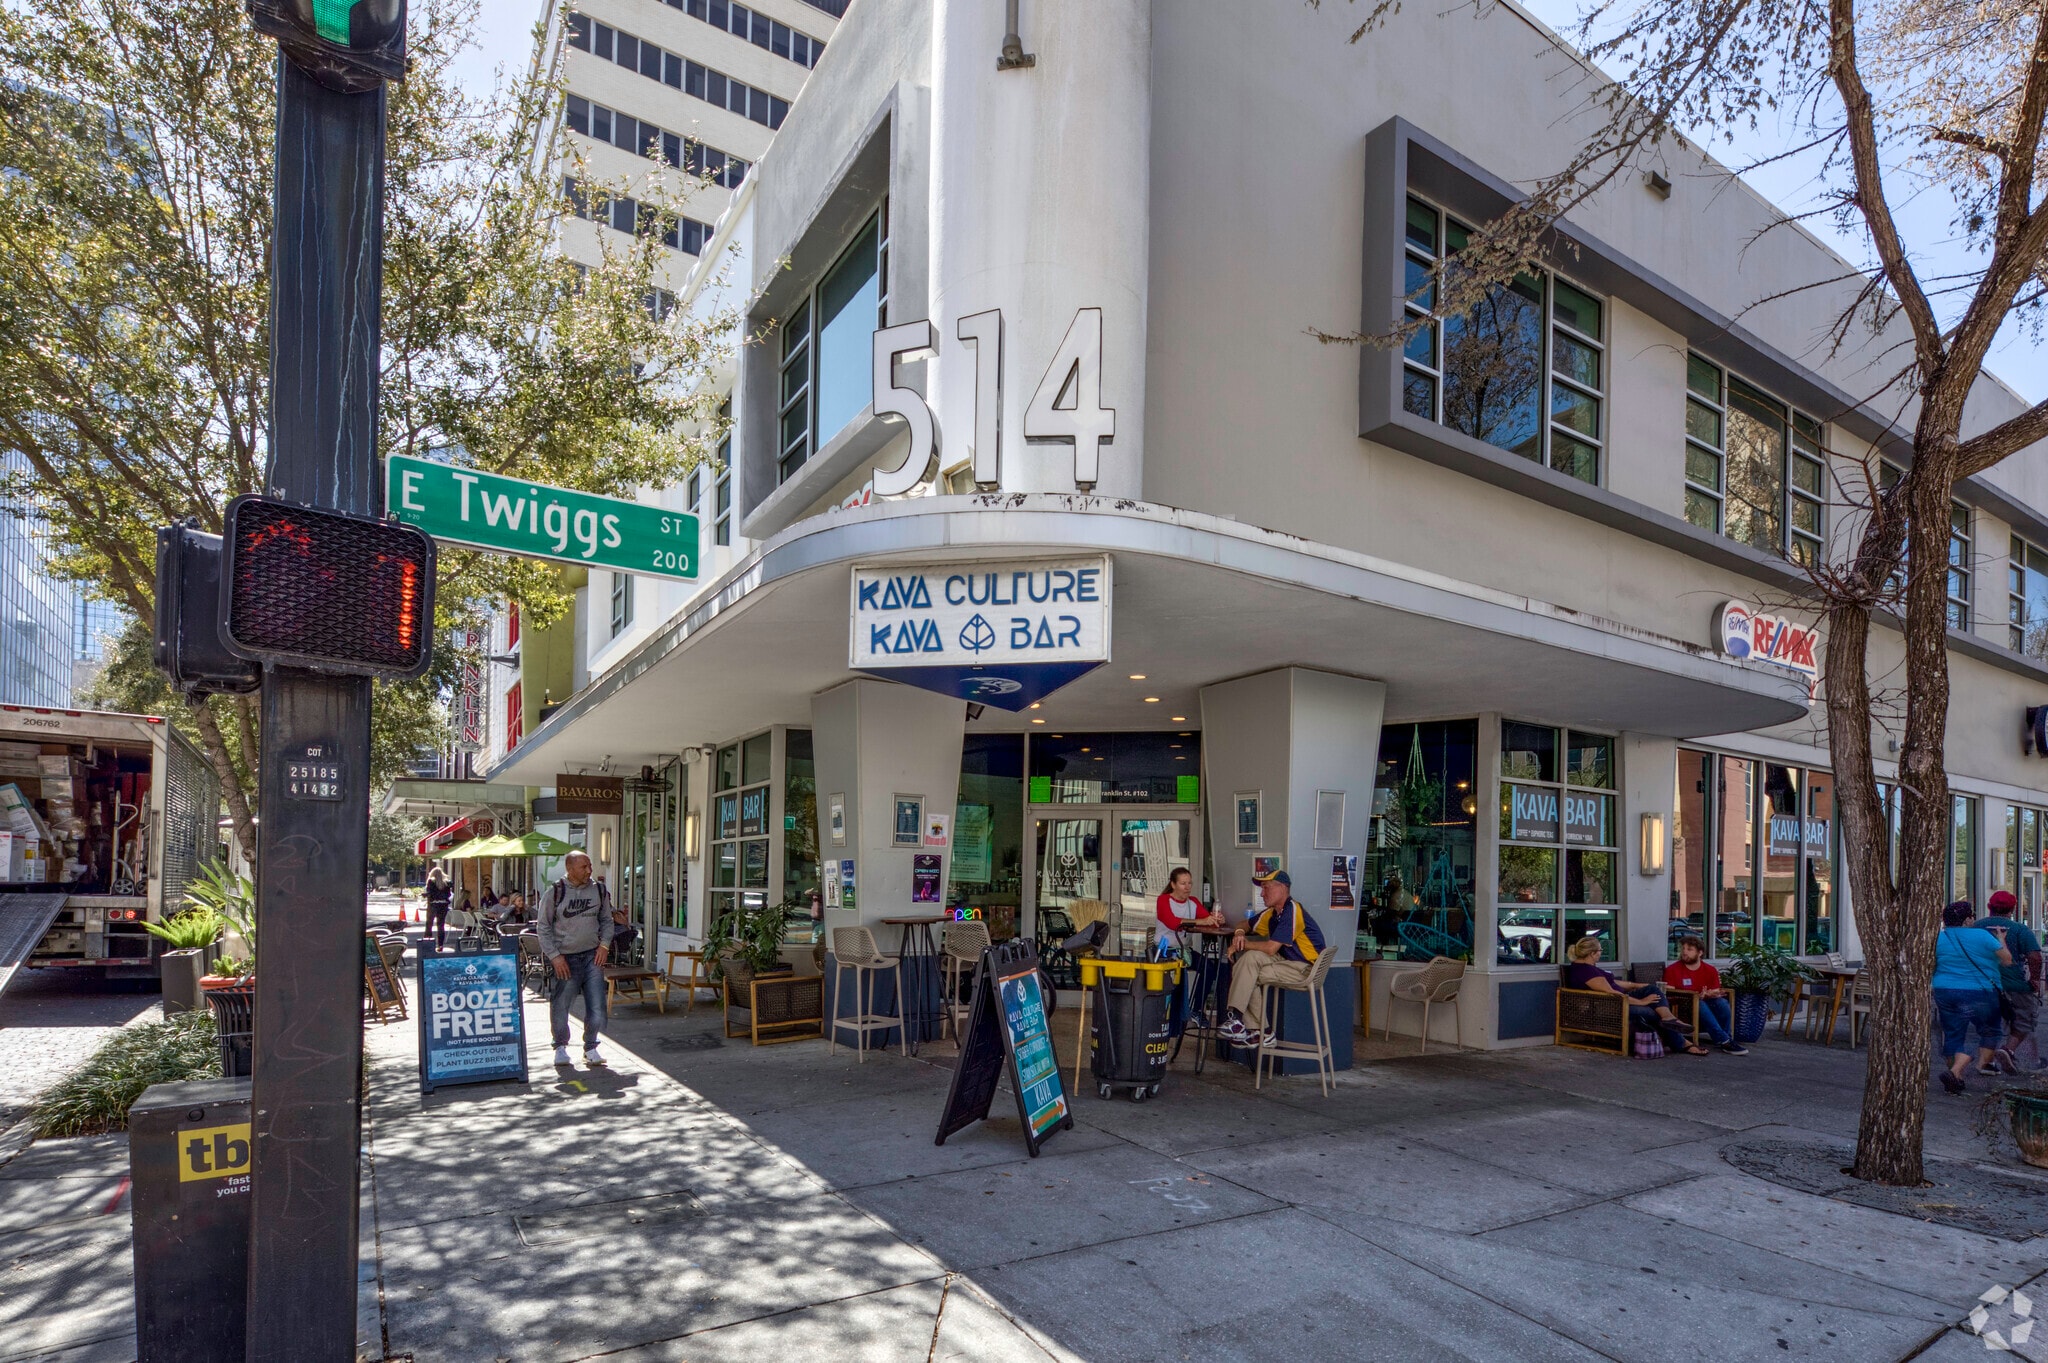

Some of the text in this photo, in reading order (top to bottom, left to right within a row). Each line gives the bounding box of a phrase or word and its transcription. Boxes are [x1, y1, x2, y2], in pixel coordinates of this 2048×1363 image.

[873, 307, 1116, 496] 514
[402, 470, 682, 558] E Twiggs ST
[653, 550, 689, 572] 200
[859, 568, 1100, 611] KAVA CULTURE
[871, 615, 1081, 655] KAVA BAR
[1753, 616, 1816, 668] RE/MAX
[23, 718, 61, 728] 206762
[307, 748, 322, 757] COT
[290, 766, 337, 779] 25185
[290, 783, 337, 796] 41432
[560, 786, 623, 799] BAVARO'S
[723, 794, 760, 822] KAV BAR
[1516, 792, 1596, 827] KAVA BAR
[1773, 818, 1824, 845] KAVA BAR
[431, 988, 513, 1013] BOOZE
[432, 1008, 515, 1040] FREE
[436, 1054, 515, 1068] PLANT BUZZ BREWS!
[443, 1046, 507, 1059] CHECK OUT OUR
[1033, 1079, 1053, 1108] KAVA
[216, 1186, 238, 1198] you
[228, 1175, 251, 1186] fast
